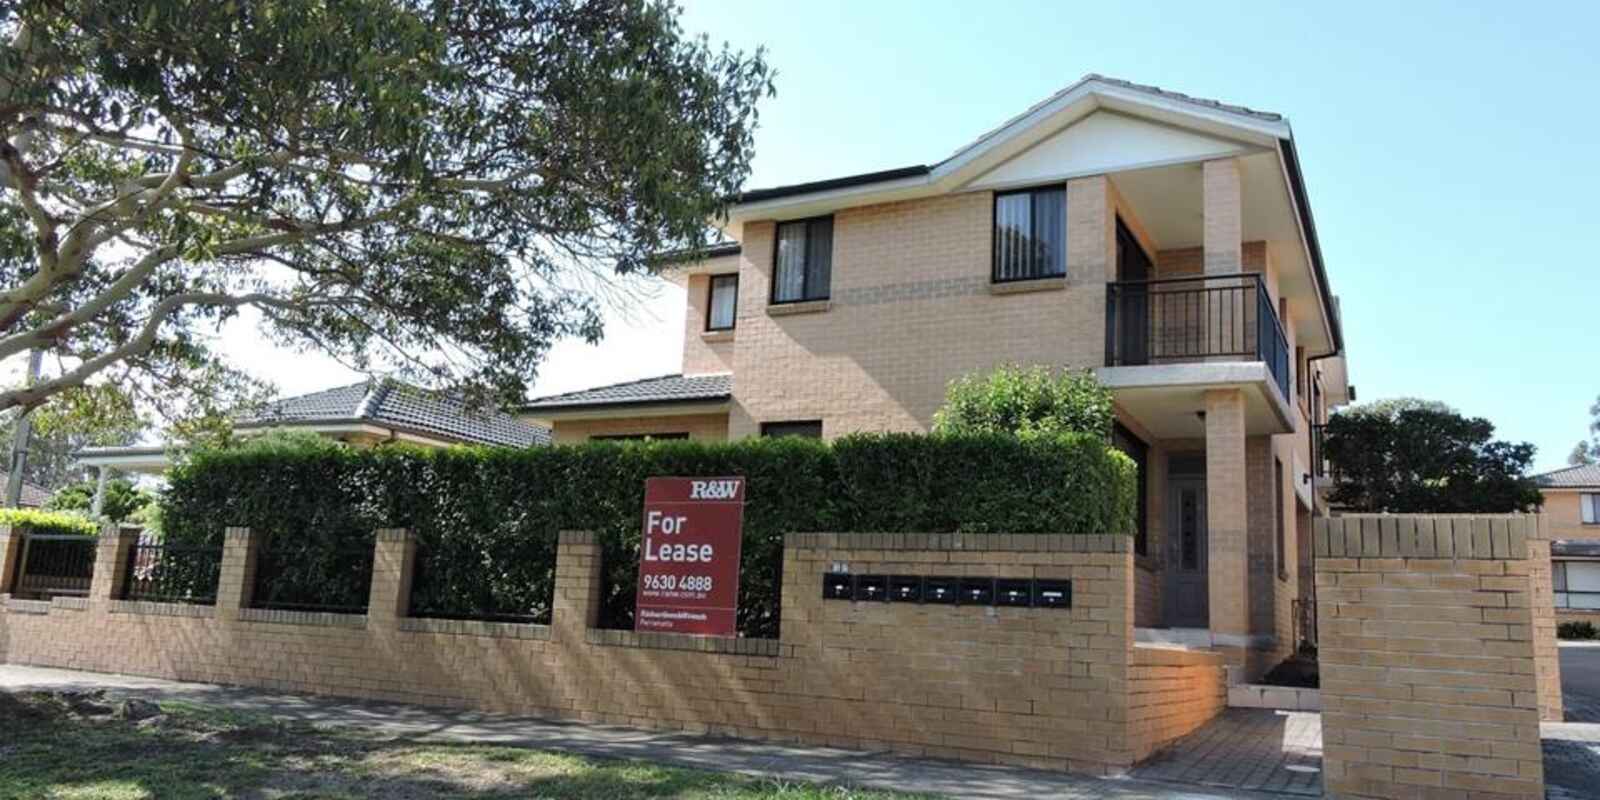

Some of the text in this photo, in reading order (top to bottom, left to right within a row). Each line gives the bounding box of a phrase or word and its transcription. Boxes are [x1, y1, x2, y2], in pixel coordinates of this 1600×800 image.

[689, 480, 740, 499] R&W
[647, 511, 687, 534] For
[645, 538, 713, 562] Lease
[643, 574, 713, 592] 9630 4888
